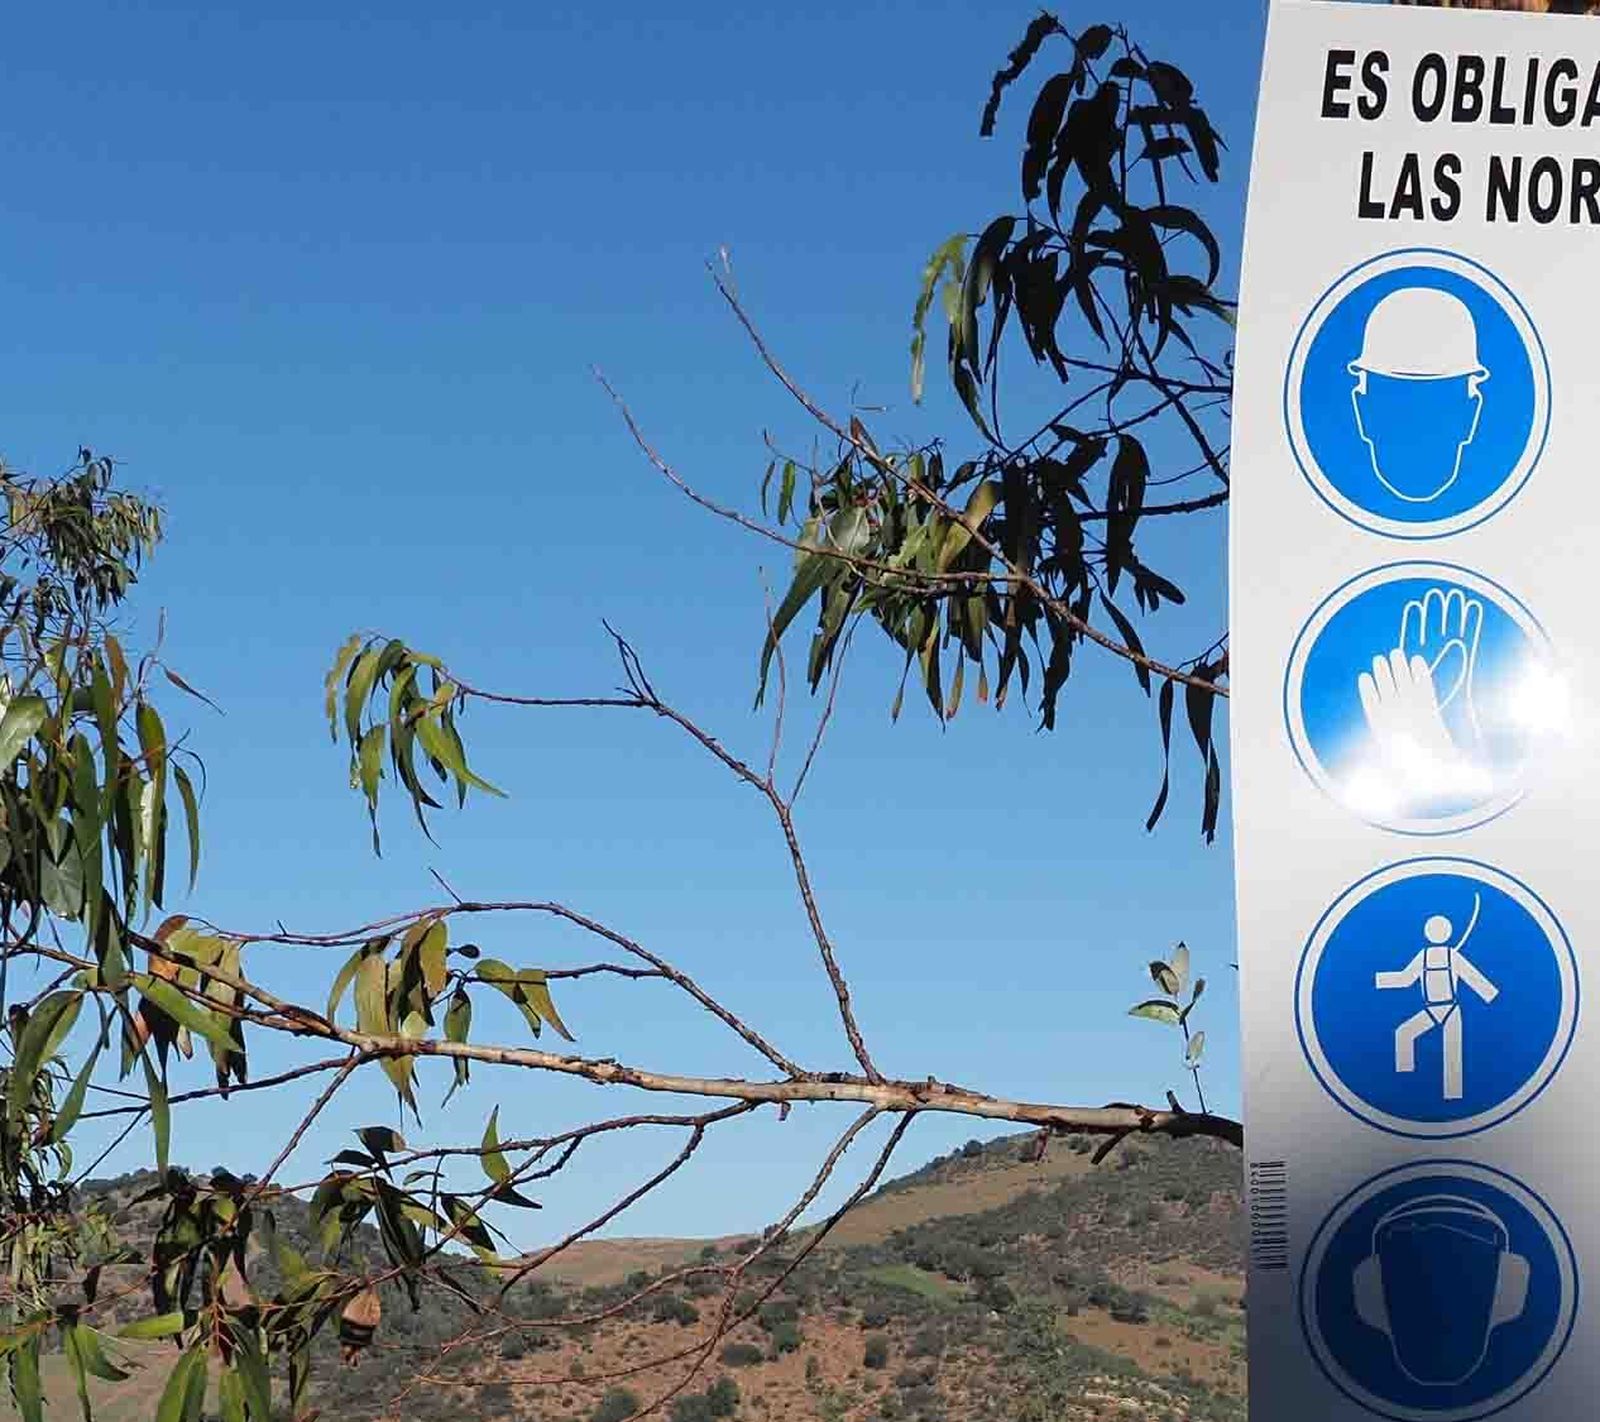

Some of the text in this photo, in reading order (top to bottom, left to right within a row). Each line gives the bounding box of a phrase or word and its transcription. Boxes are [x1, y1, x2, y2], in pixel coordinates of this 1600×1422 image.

[1320, 49, 1390, 121] ES
[1357, 151, 1600, 225] LAS NOR
